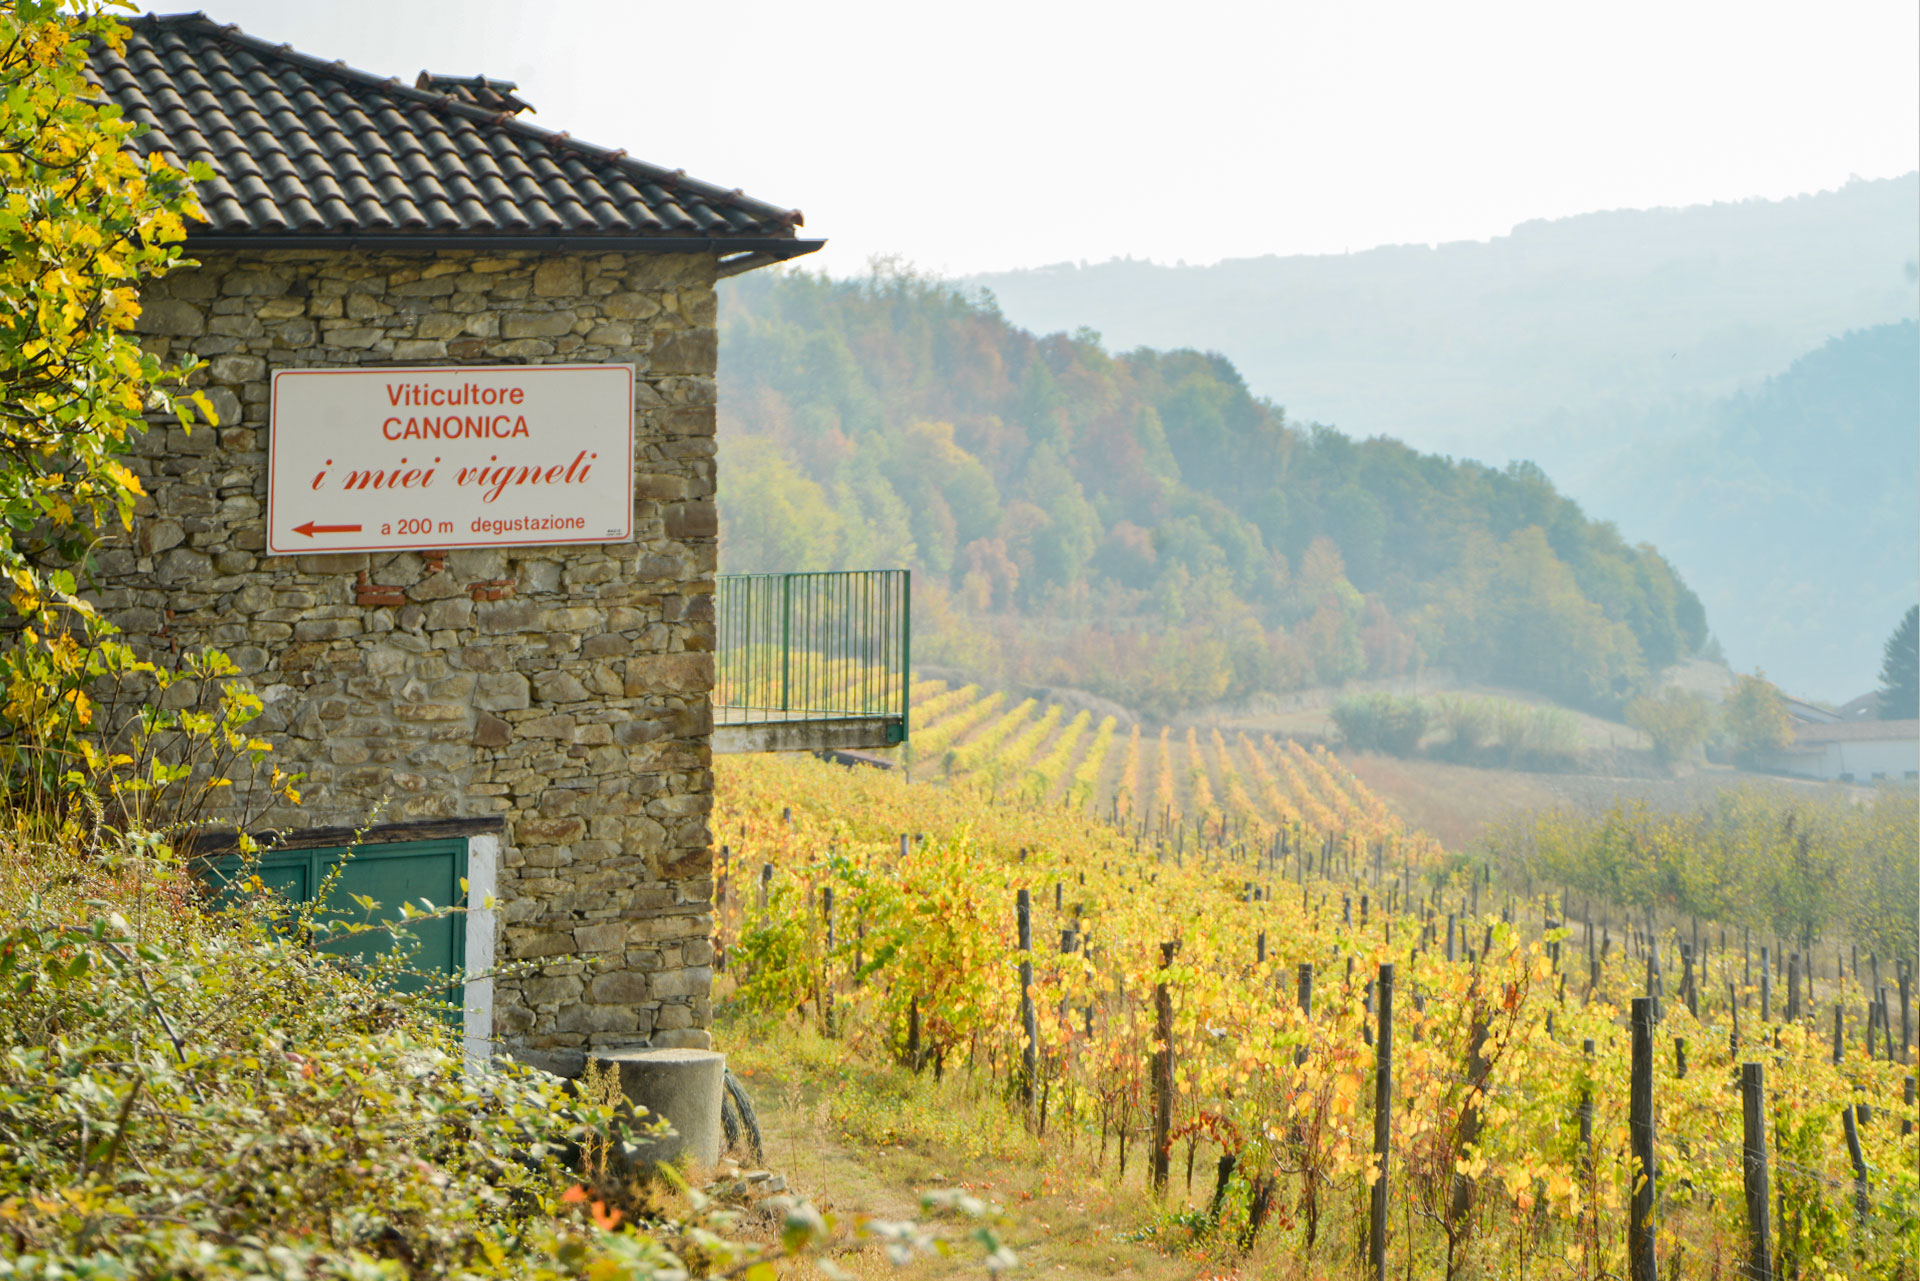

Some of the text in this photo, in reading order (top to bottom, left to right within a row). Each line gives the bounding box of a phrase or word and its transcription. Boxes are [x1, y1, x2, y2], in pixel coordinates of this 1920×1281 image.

[385, 382, 525, 408] Viticultore
[381, 414, 531, 442] CANONICA
[310, 449, 599, 505] i miei vigneti
[380, 522, 392, 537] a
[397, 518, 434, 537] 200
[437, 520, 455, 535] m
[470, 514, 586, 537] degustazione
